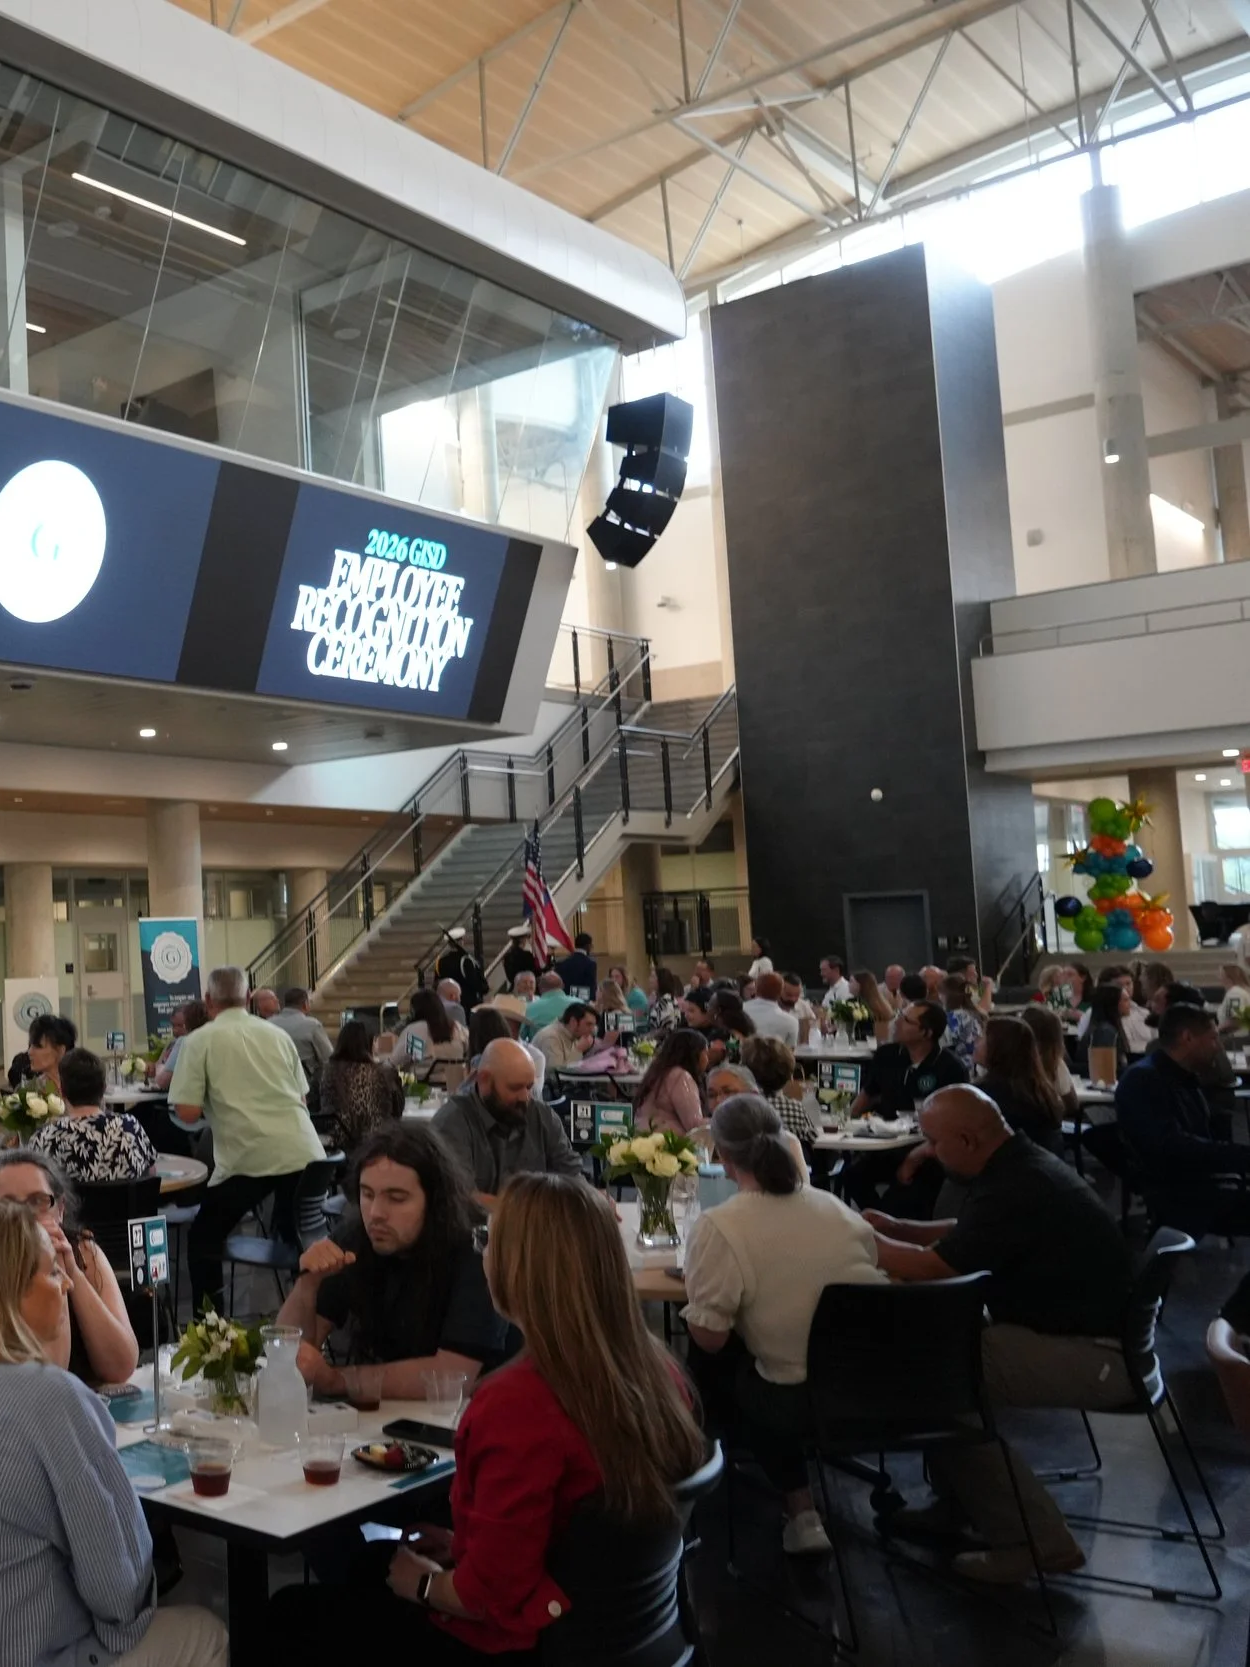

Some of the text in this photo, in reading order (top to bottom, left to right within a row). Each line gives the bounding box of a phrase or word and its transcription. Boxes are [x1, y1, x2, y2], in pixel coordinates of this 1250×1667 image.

[364, 528, 447, 570] 2026 GISD
[329, 549, 466, 615] EMPLOYEE
[290, 585, 474, 659] RECOGNITION
[306, 632, 454, 692] CEREMONY
[27, 1005, 39, 1018] G
